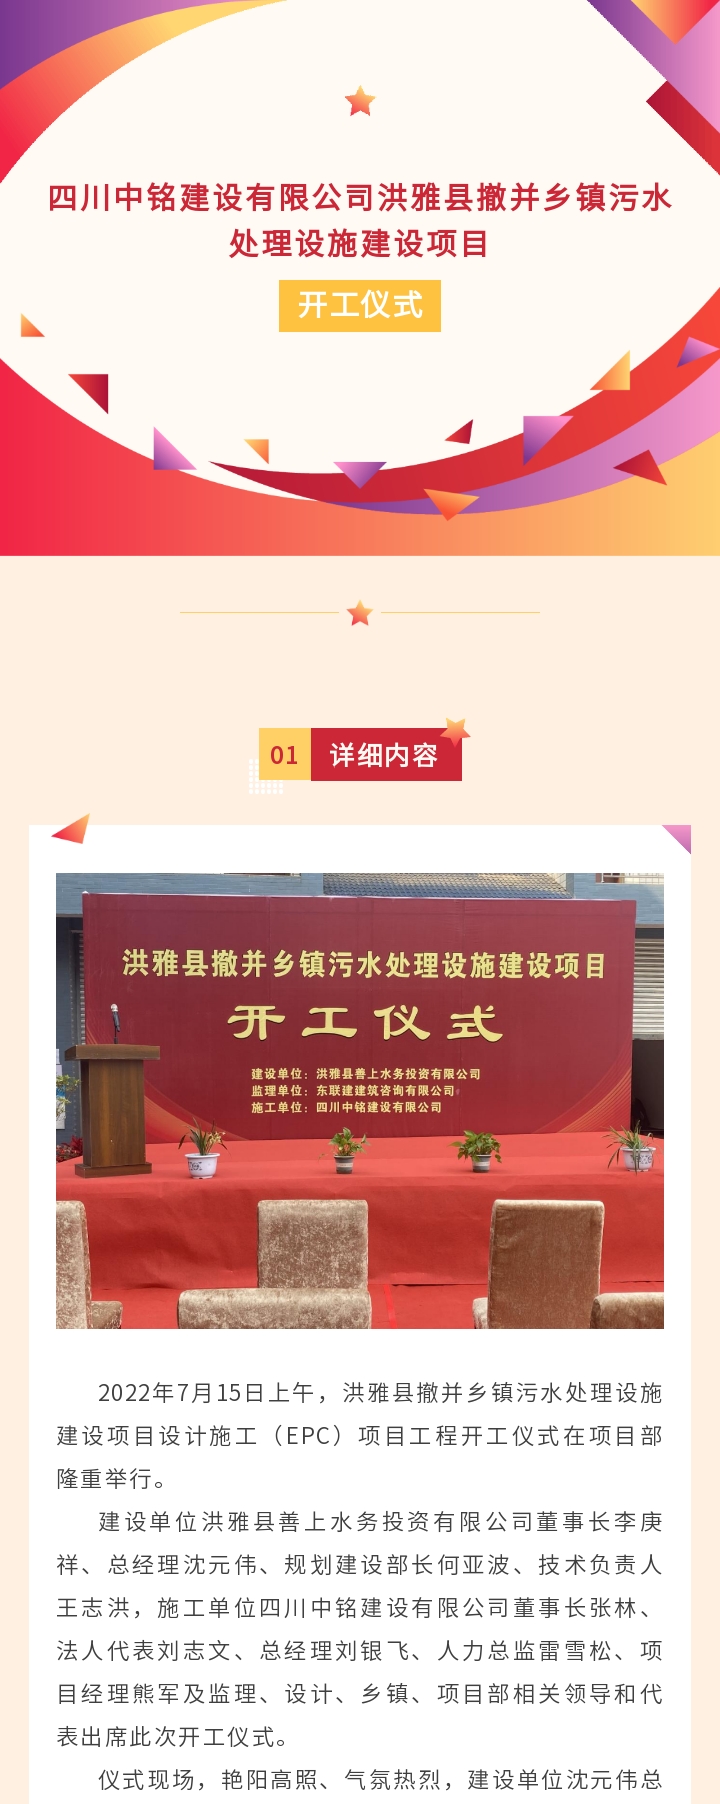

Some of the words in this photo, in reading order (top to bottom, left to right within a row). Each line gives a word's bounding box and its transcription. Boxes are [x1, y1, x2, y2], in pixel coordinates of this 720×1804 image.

[49, 182, 672, 212] 四川中铭建设有限公司洪雅县撤并乡镇污水
[229, 229, 486, 258] 处理设施建设项目
[299, 291, 423, 318] 开工仪式
[271, 746, 297, 764] 01
[330, 743, 437, 767] 详细内容
[122, 949, 605, 980] 洪雅县撤并乡镇污水处理设施建设项目
[227, 1004, 504, 1043] 开工仪式
[99, 1382, 662, 1404] 2022年7月15日上午，洪雅县撤并乡镇污水处理设施
[57, 1468, 165, 1490] 隆重举行。
[98, 1511, 662, 1533] 建设单位洪雅县善上水务投资有限公司董事长李庚
[56, 1554, 662, 1576] 祥、总经理沈元伟、规划建设部长何亚波、技术负责人
[56, 1597, 651, 1619] 王志洪，施工单位四川中铭建设有限公司董事长张林、
[56, 1640, 663, 1662] 法人代表刘志文、总经理刘银飞、人力总监雷雪松、项
[57, 1683, 663, 1705] 目经理熊军及监理、设计、乡镇、项目部相关领导和代
[56, 1726, 287, 1748] 表出席此次开工仪式。
[98, 1769, 662, 1791] 仪式现场，艳阳高照、气氛热烈，建设单位沈元伟总
